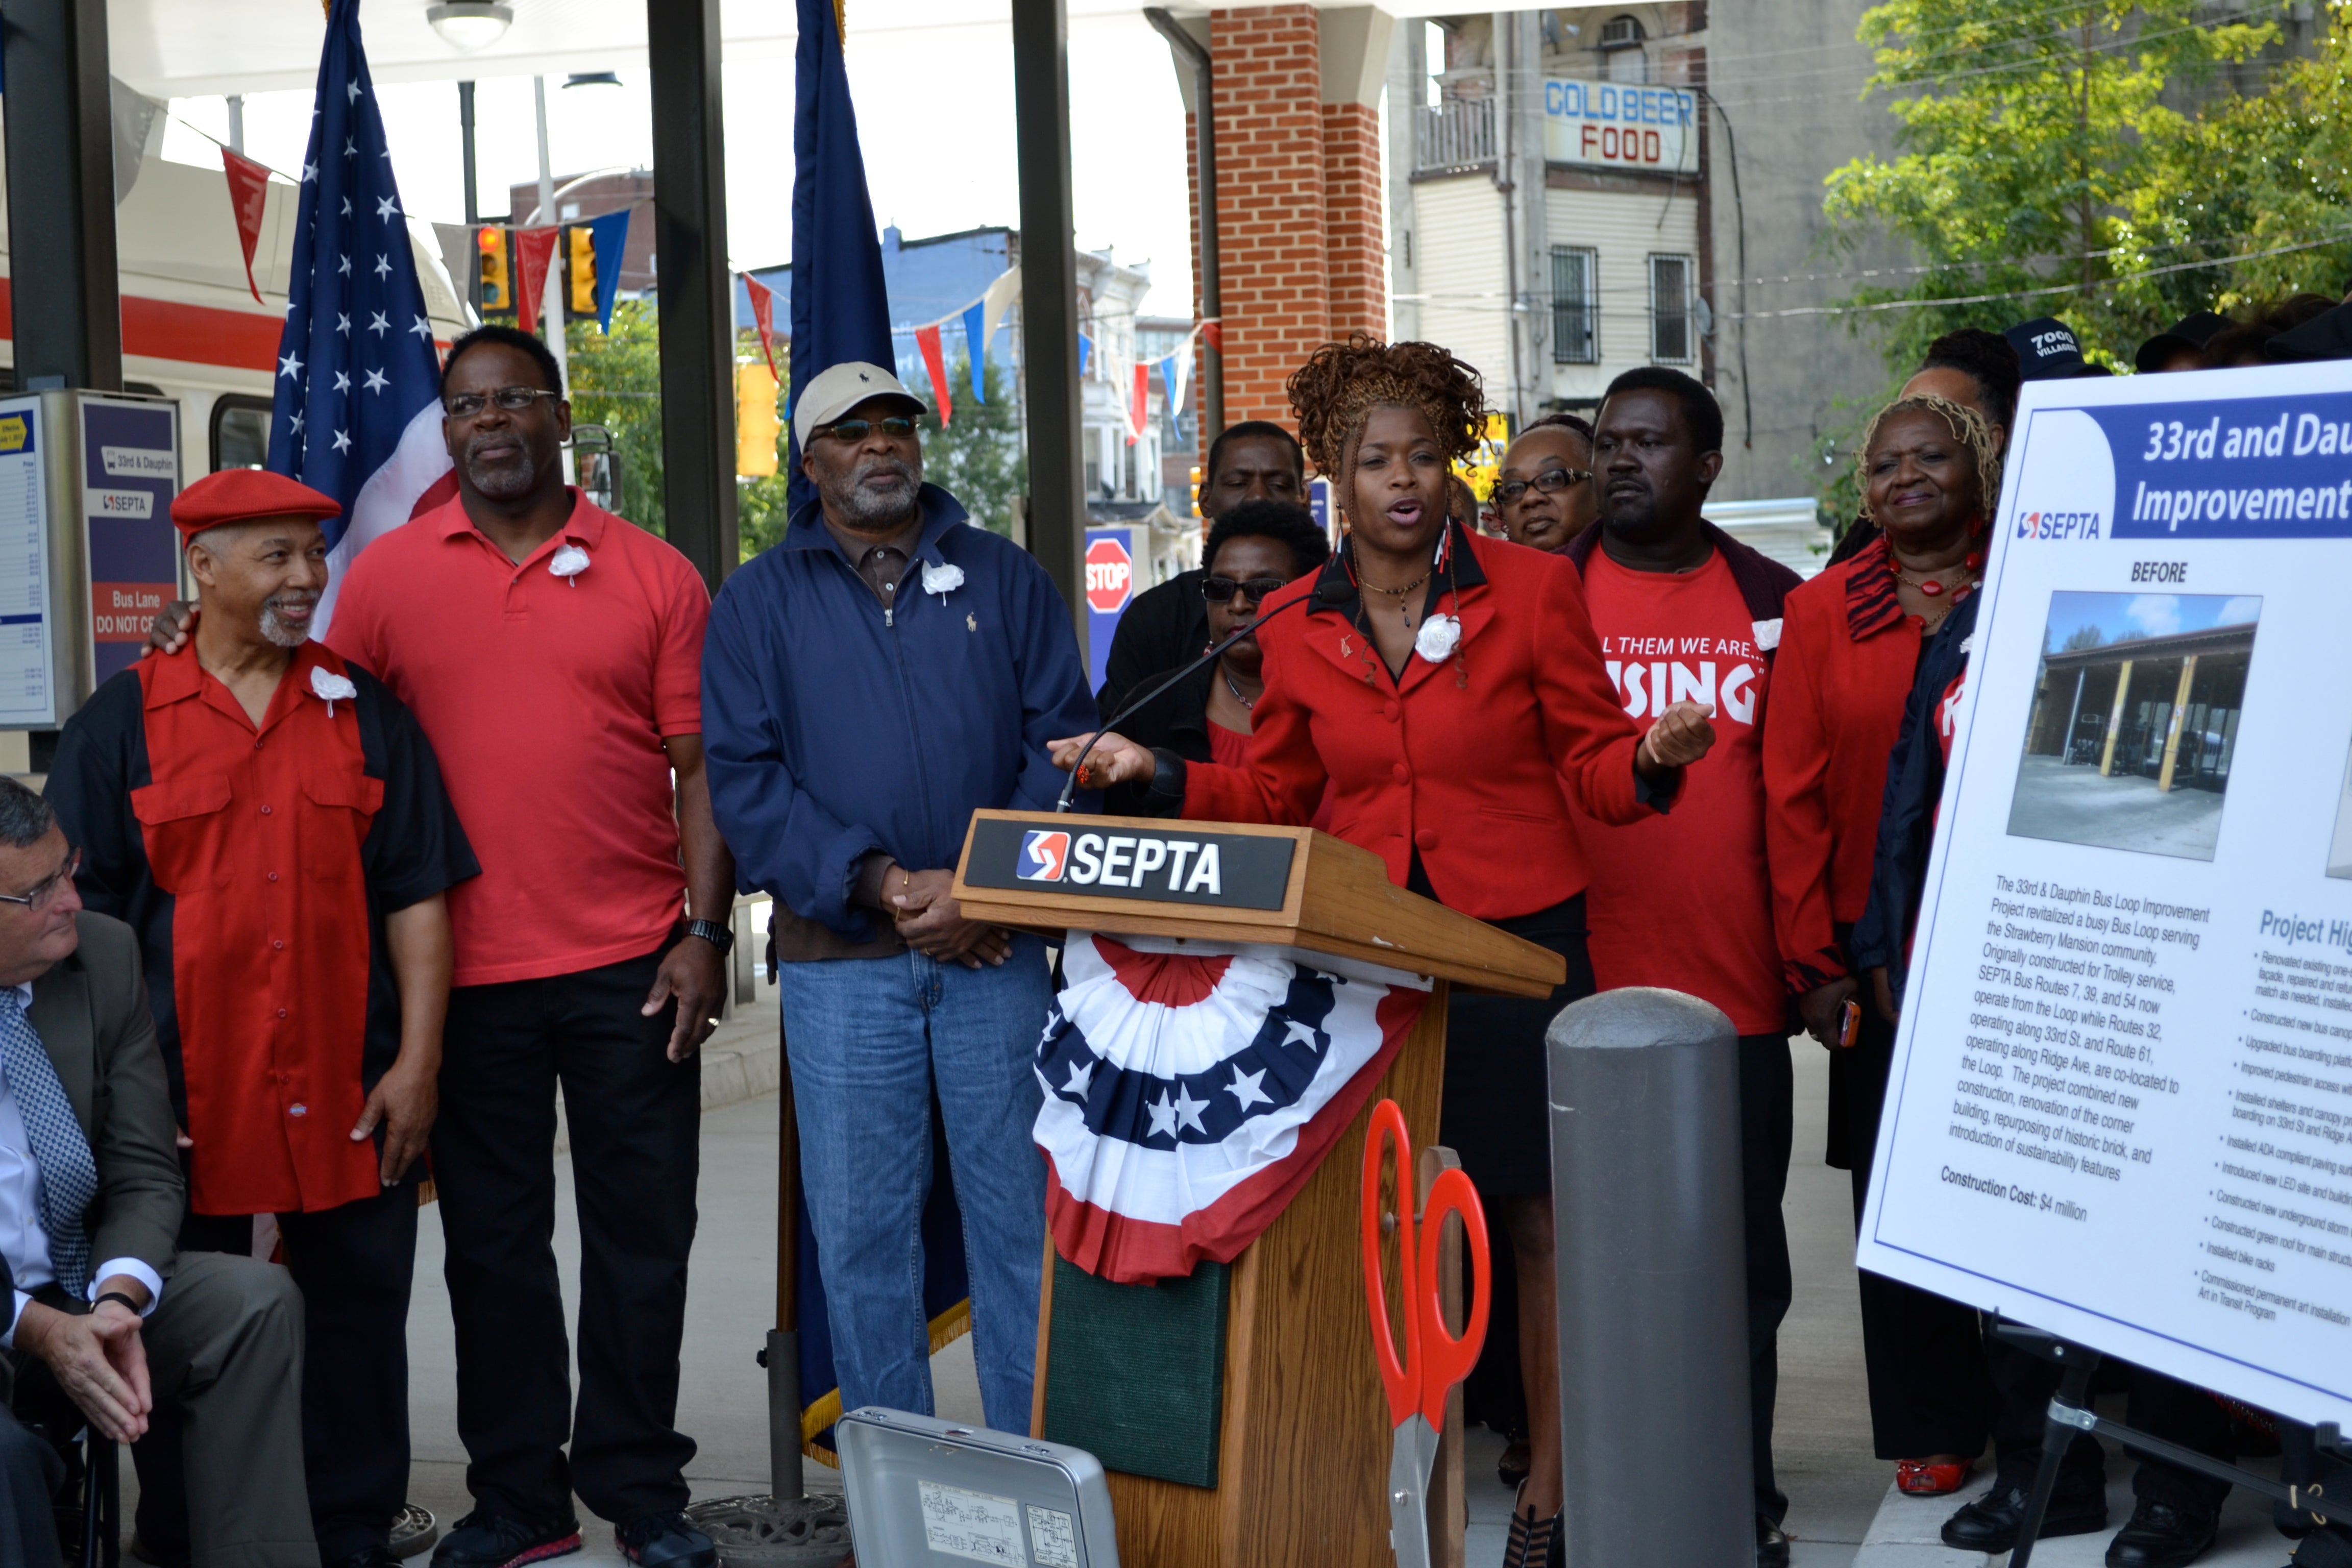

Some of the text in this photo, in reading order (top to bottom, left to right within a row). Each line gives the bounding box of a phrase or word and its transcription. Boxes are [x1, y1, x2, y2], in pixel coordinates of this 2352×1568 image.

[1546, 81, 1692, 127] COLD BEER
[1582, 125, 1660, 163] FOOD
[2031, 331, 2074, 349] 7000
[2144, 416, 2220, 461] 33rd
[2223, 412, 2289, 458] and
[118, 455, 173, 472] 33rd & Dauphin
[115, 496, 145, 511] SEPTA
[2039, 512, 2099, 540] SEPTA
[2133, 481, 2352, 531] Improvement
[1086, 562, 1129, 591] STOP
[2131, 562, 2188, 583] BEFORE
[113, 590, 160, 608] Bus Lane
[96, 616, 138, 633] DO NOT
[1619, 637, 1674, 655] THEM
[1681, 638, 1710, 654] WE
[1070, 833, 1221, 895] SEPTA
[1997, 874, 2210, 923] The 33rd & Dauphin Bus Loop Improvement
[1987, 920, 2157, 968] the Strawberry Mansion community.
[1991, 897, 2200, 950] Project revitalized a busy Bus Loop serving
[2260, 909, 2324, 945] Project
[1978, 964, 2161, 1014] SEPTA Bus Routes 7, 39, and 54 now
[1982, 942, 2175, 994] Originally constructed for Trolley service,
[1970, 1013, 2153, 1065] operating along 33rd St. and Route 61,
[1974, 990, 2162, 1042] operate from the Loop while Routes 32,
[1962, 1055, 2140, 1110] the Loop. The project combined new
[1966, 1035, 2179, 1094] operating along Ridge Ave, are co-located to
[1953, 1098, 2152, 1164] building, repurposing of historic brick, and
[1957, 1080, 2135, 1134] construction, renovation of the corner
[1949, 1121, 2121, 1182] introduction of sustainability features
[1941, 1165, 2087, 1221] Construction Cost: $4 million
[2309, 1305, 2350, 1326] installation
